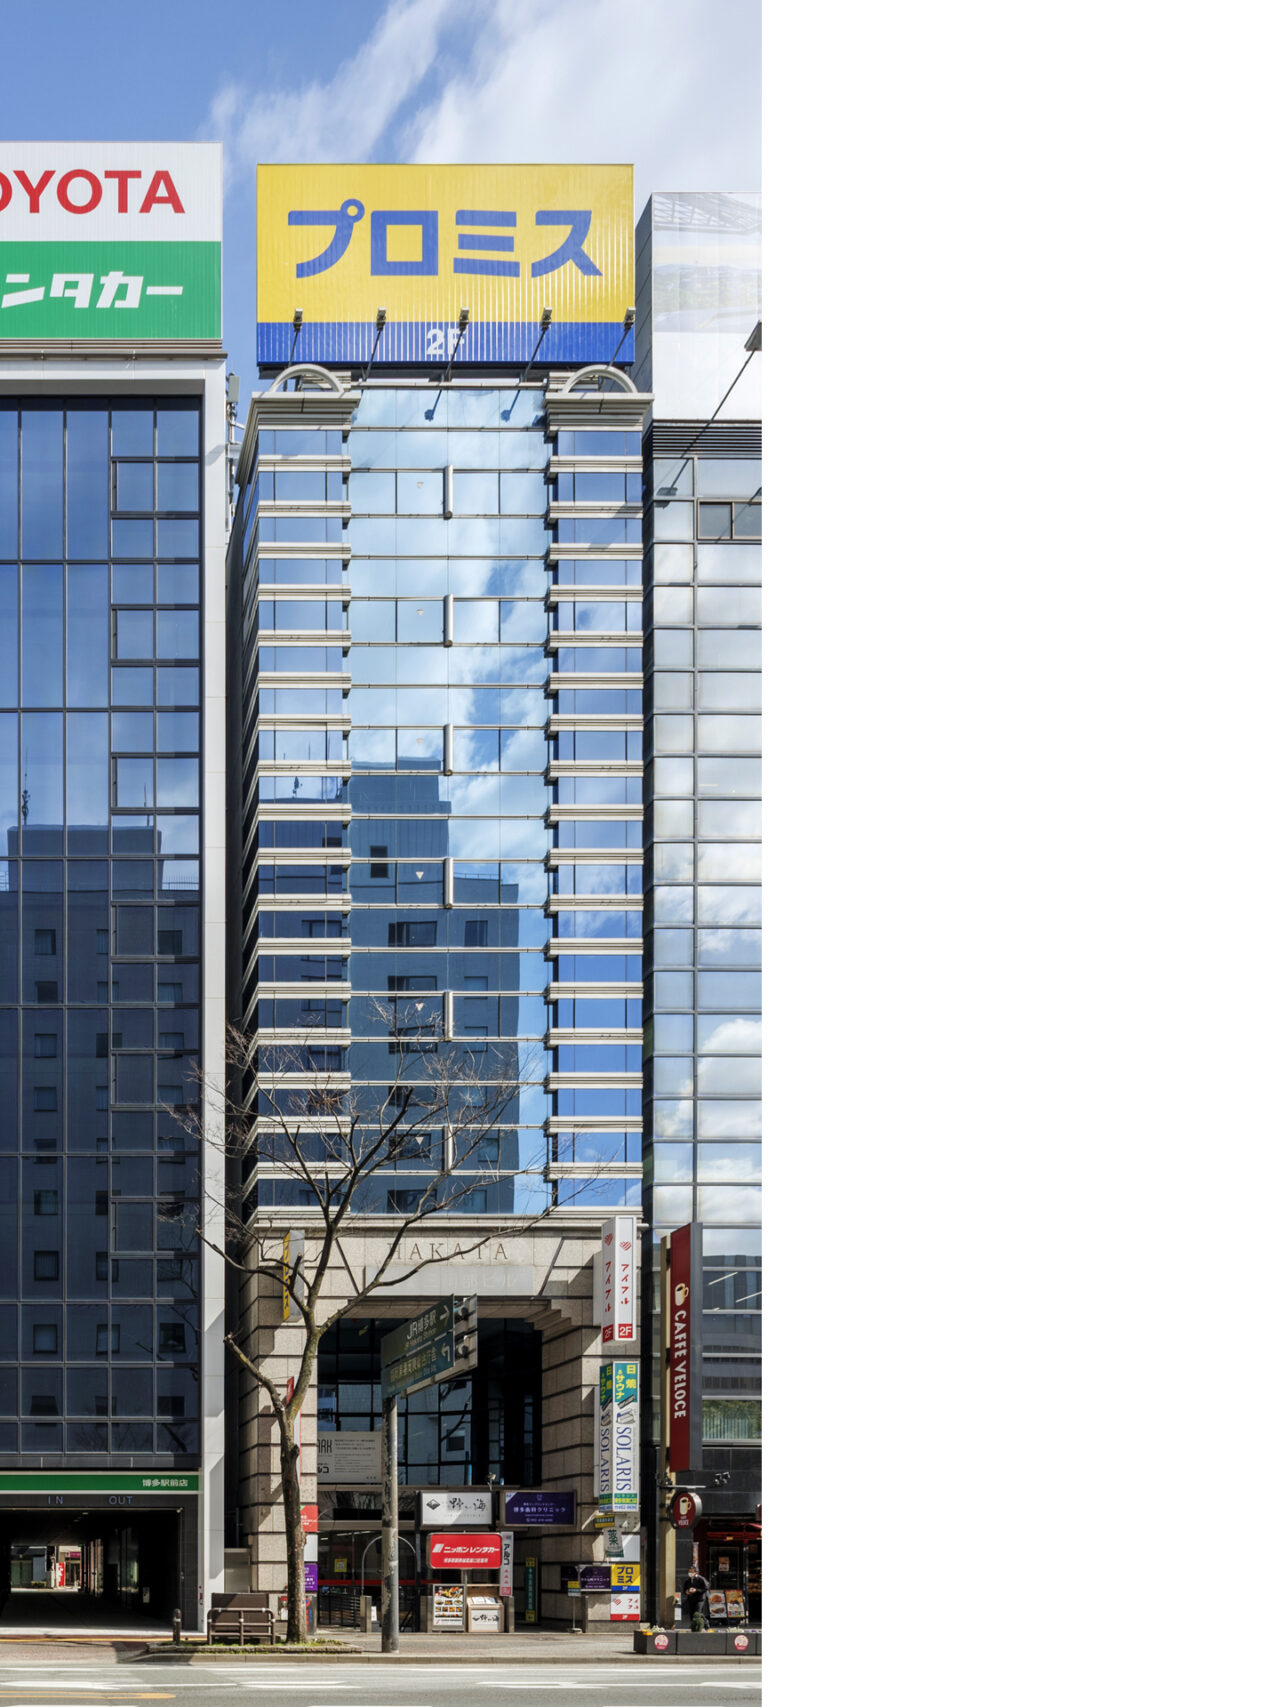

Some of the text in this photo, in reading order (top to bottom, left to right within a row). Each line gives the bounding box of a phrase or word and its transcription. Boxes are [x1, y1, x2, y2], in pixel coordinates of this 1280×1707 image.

[287, 198, 603, 279] プロミス
[425, 328, 465, 356] 2F
[387, 1242, 508, 1261] HAKATA
[620, 1263, 630, 1305] アイフル
[604, 1328, 612, 1340] 2F
[619, 1327, 632, 1336] 2F
[674, 1309, 687, 1419] CAFFE VELOCE
[600, 1428, 610, 1492] SOLARIS
[616, 1427, 631, 1490] SOLARIS
[142, 1479, 189, 1487] 博多駅前店
[48, 1495, 64, 1505] IN
[108, 1495, 133, 1505] OUT
[607, 1529, 619, 1546] 薬
[617, 1567, 634, 1575] プロ
[617, 1575, 634, 1583] ミス
